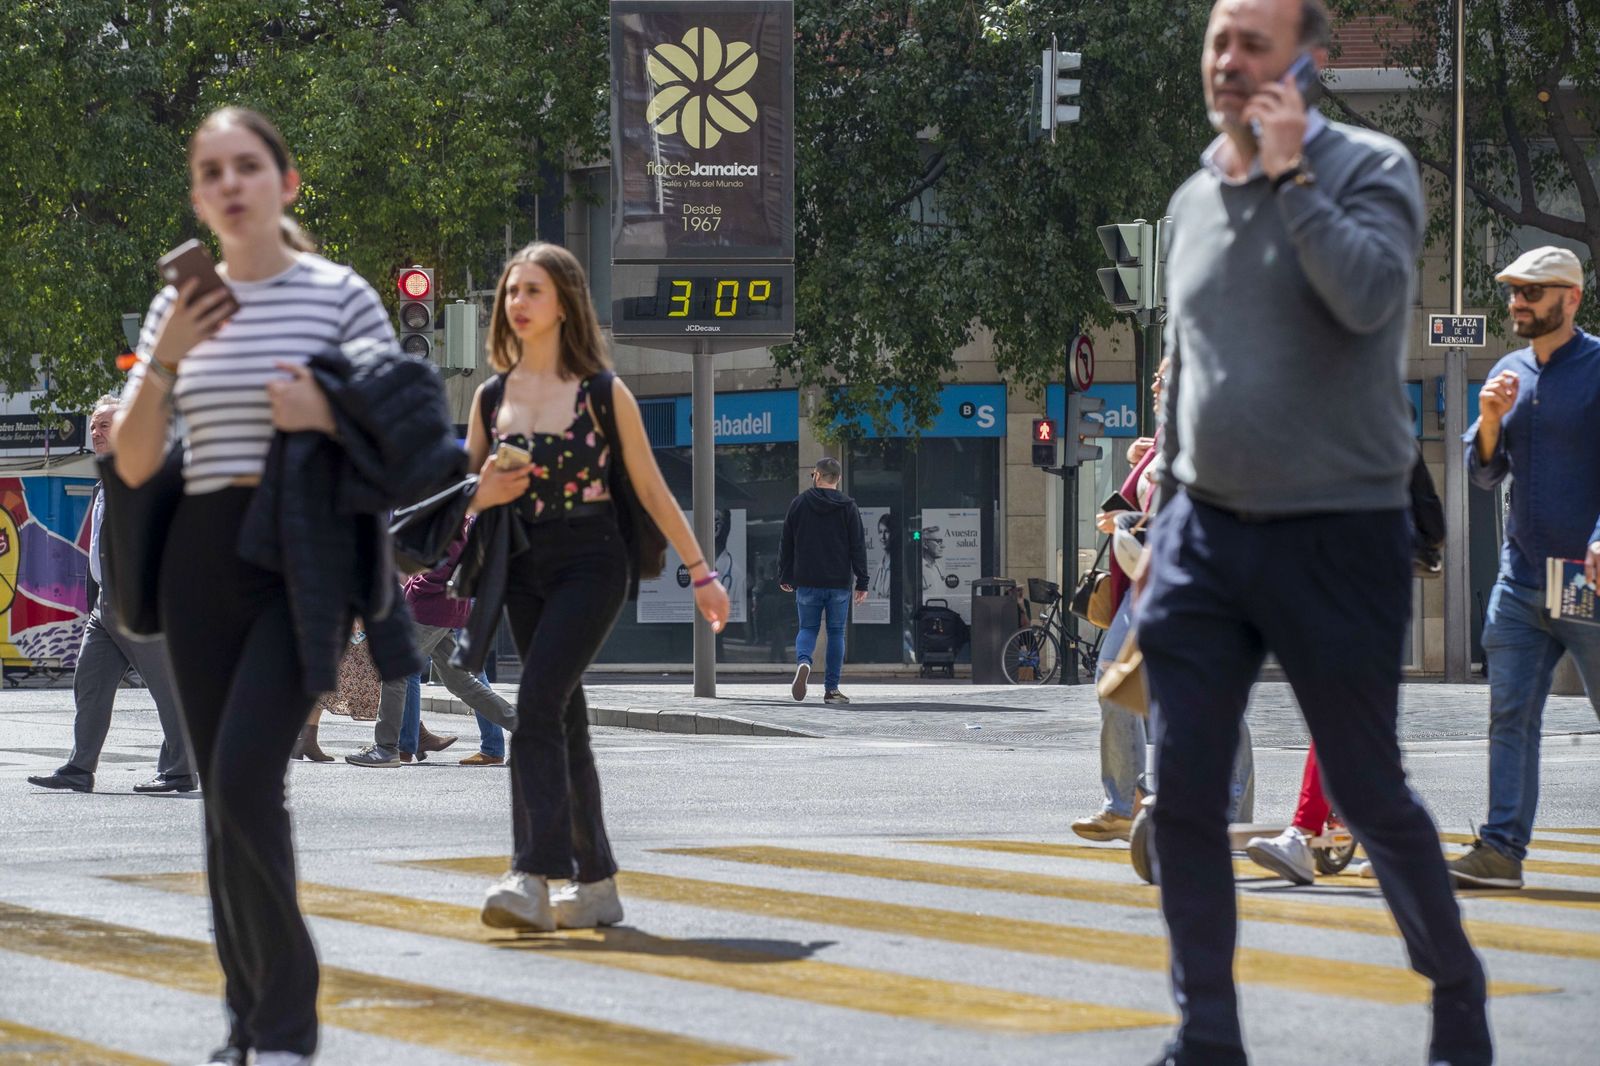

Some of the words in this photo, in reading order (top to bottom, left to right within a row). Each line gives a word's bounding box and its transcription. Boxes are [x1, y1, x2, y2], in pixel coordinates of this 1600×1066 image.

[683, 181, 688, 189] y
[689, 180, 700, 188] Tés
[702, 180, 714, 188] del
[715, 180, 744, 188] Mundo
[683, 204, 721, 215] Desde
[682, 216, 721, 231] 1967
[1452, 318, 1477, 327] PLAZA
[685, 324, 720, 332] JCDecaux
[1440, 336, 1474, 344] FUENSANTA
[976, 405, 995, 428] S
[714, 411, 771, 436] abadell
[956, 538, 978, 548] salud.
